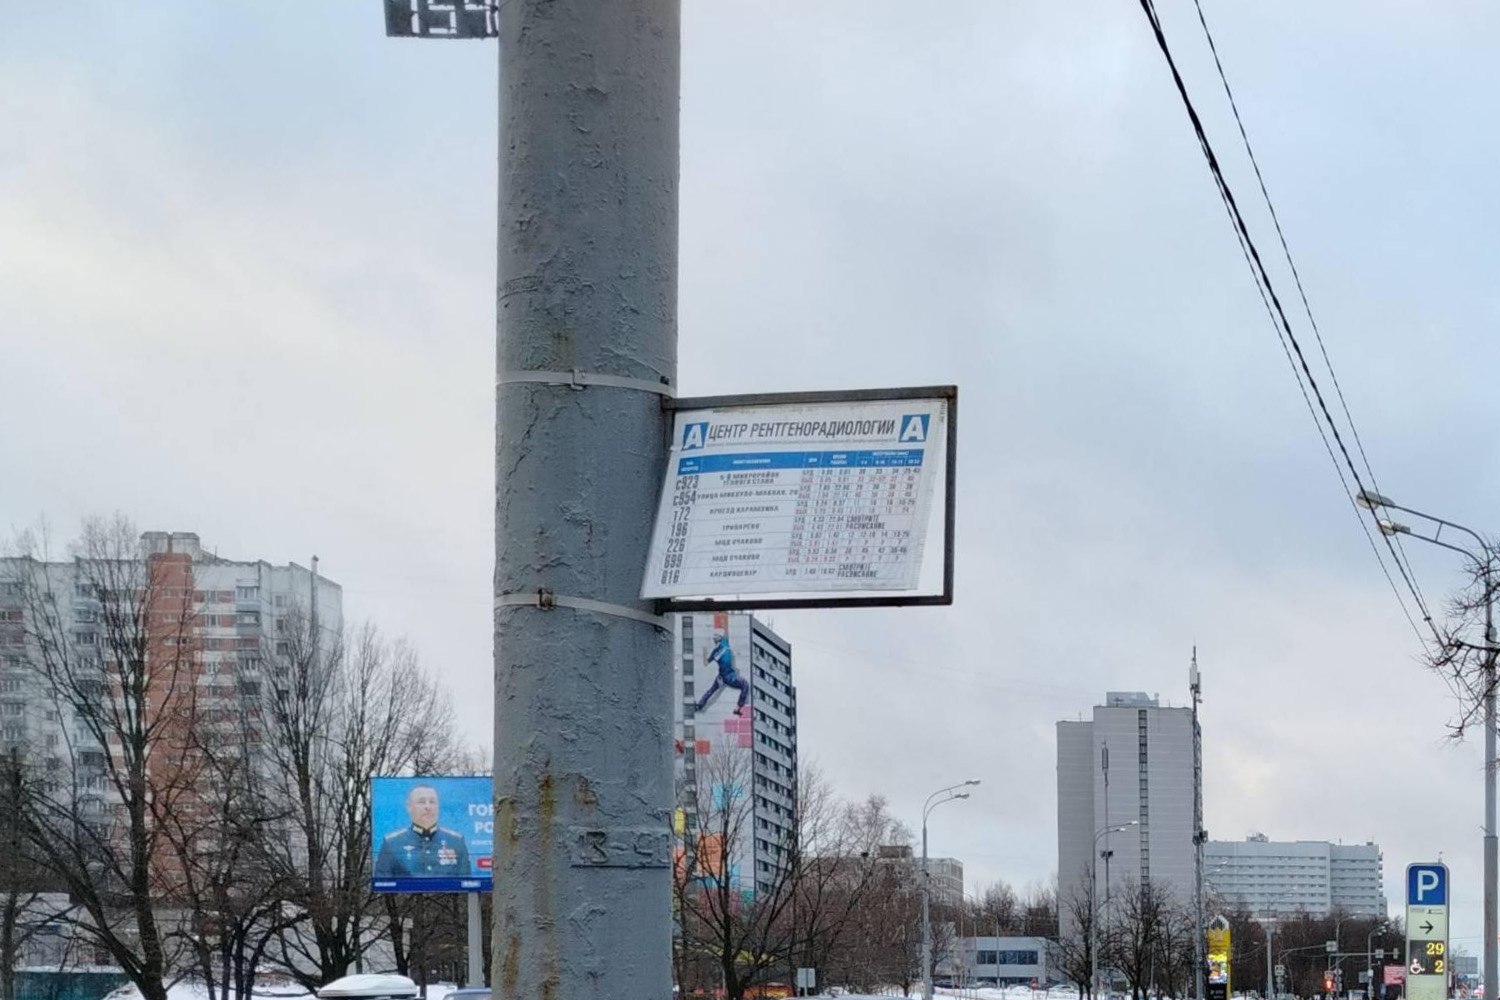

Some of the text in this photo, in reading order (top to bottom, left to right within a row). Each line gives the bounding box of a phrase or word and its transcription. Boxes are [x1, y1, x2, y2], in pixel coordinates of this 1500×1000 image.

[708, 423, 748, 441] ЦЕНТР
[750, 419, 896, 439] РЕНТГЕНОРАДИОЛОГИИ
[1417, 870, 1439, 901] P
[1426, 942, 1444, 955] 29
[1434, 960, 1444, 973] 2
